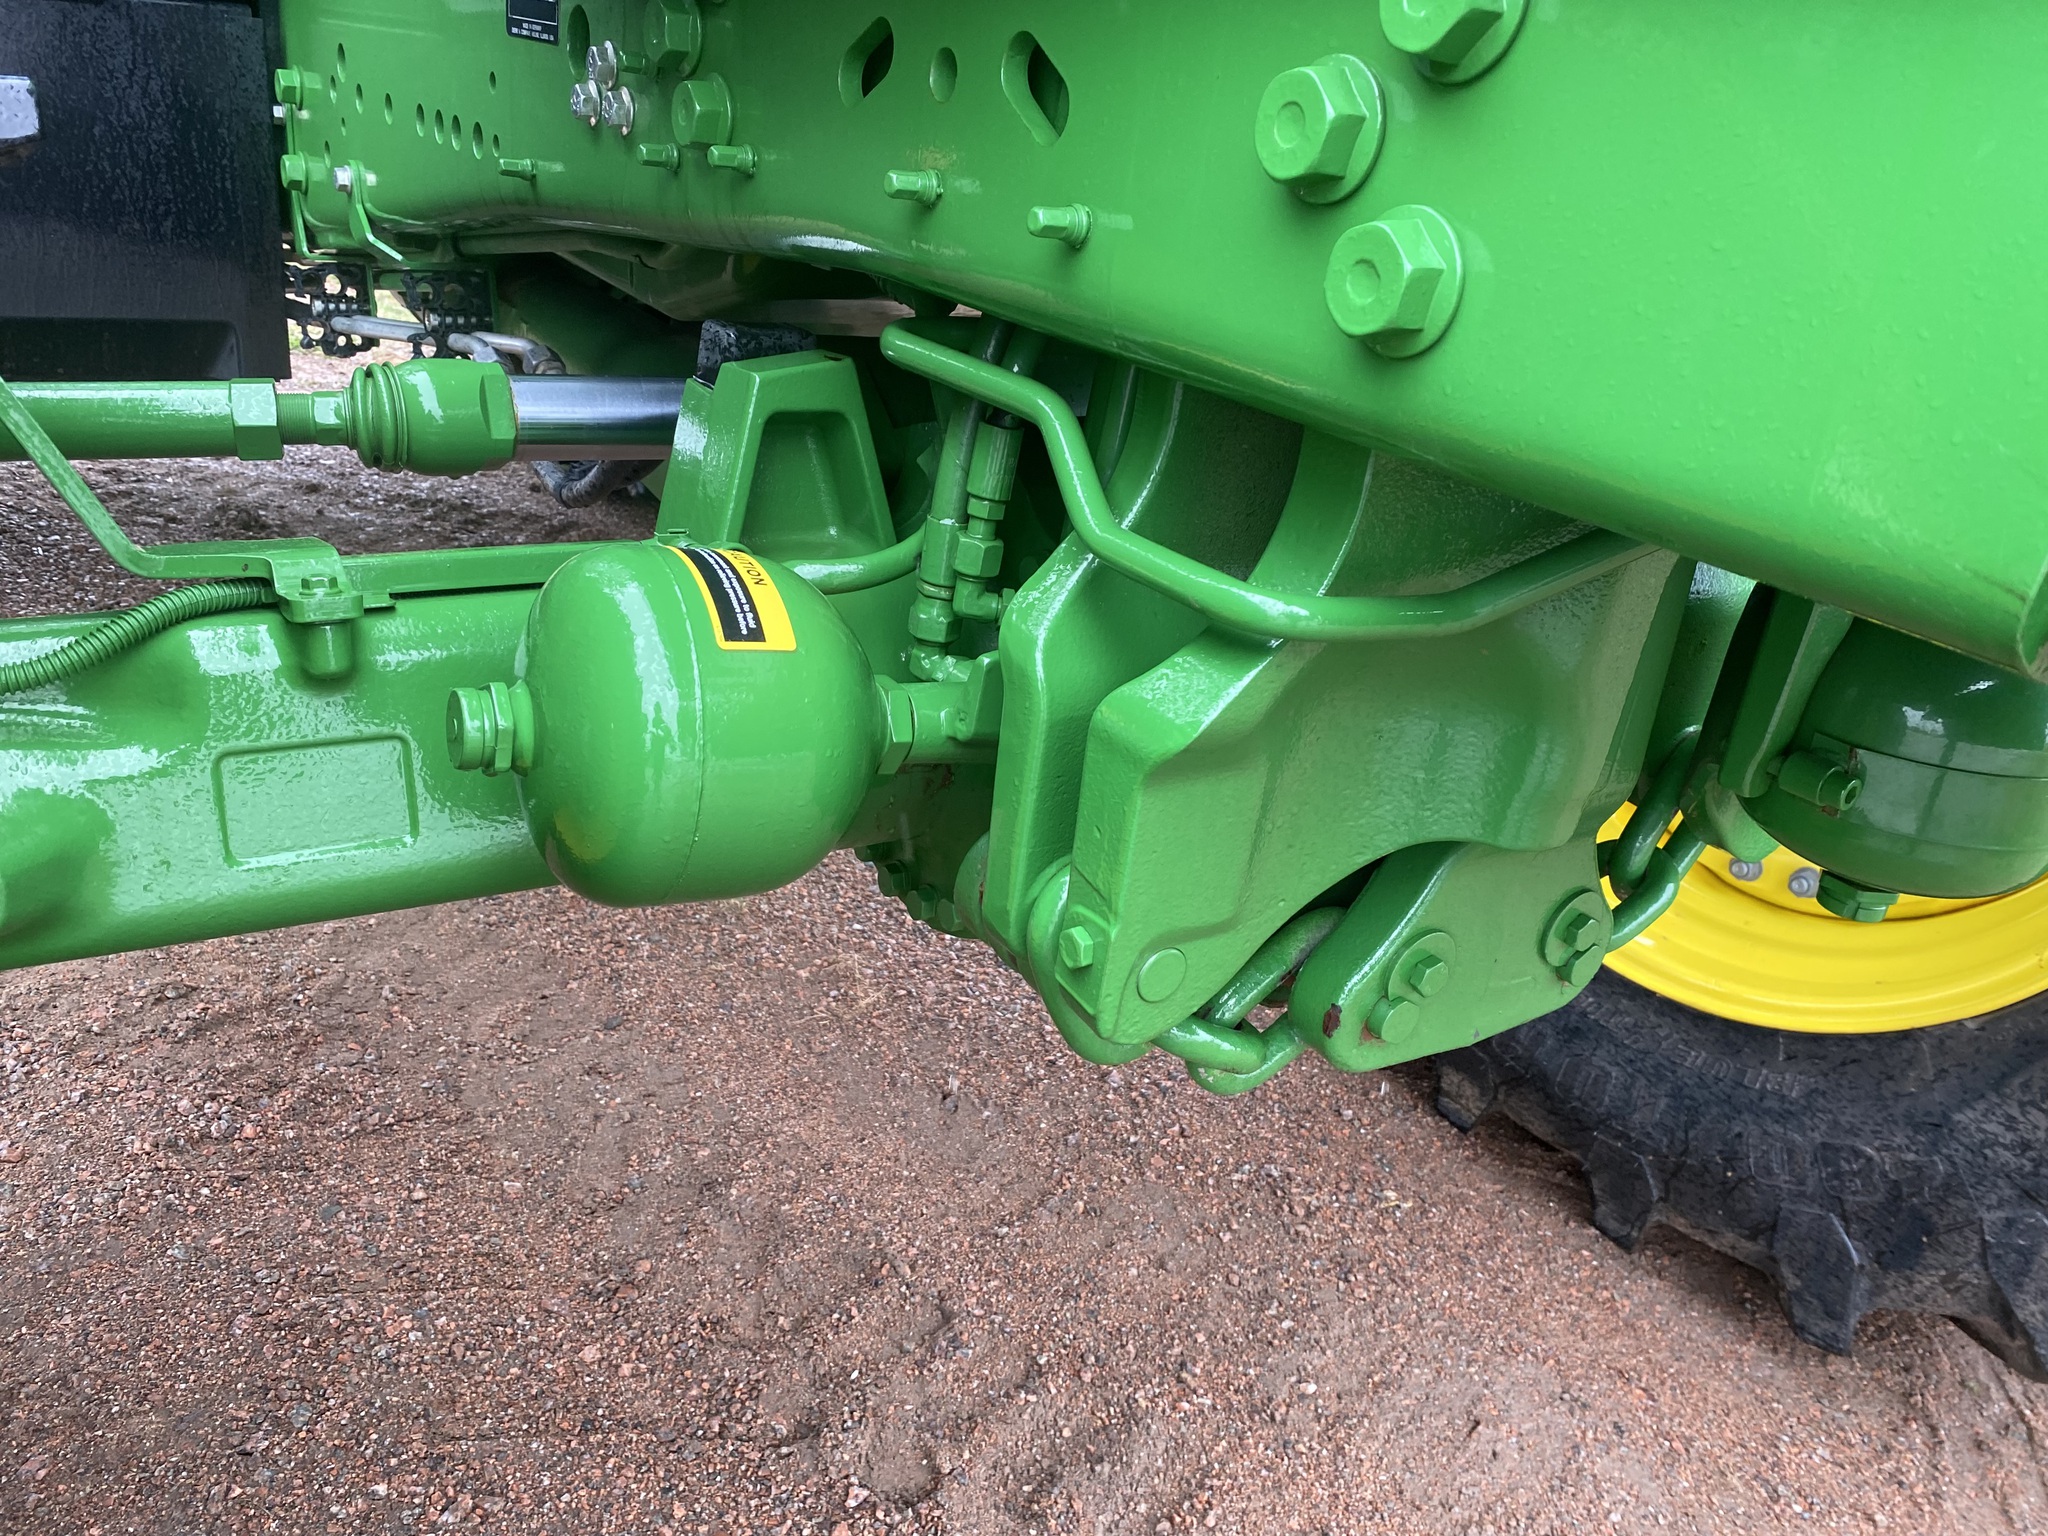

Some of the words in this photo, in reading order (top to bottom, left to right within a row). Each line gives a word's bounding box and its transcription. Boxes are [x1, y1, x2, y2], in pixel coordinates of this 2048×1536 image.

[730, 550, 768, 585] AUTION
[725, 588, 741, 613] pressure
[736, 613, 748, 635] before
[742, 604, 750, 612] to
[745, 612, 757, 628] fluid
